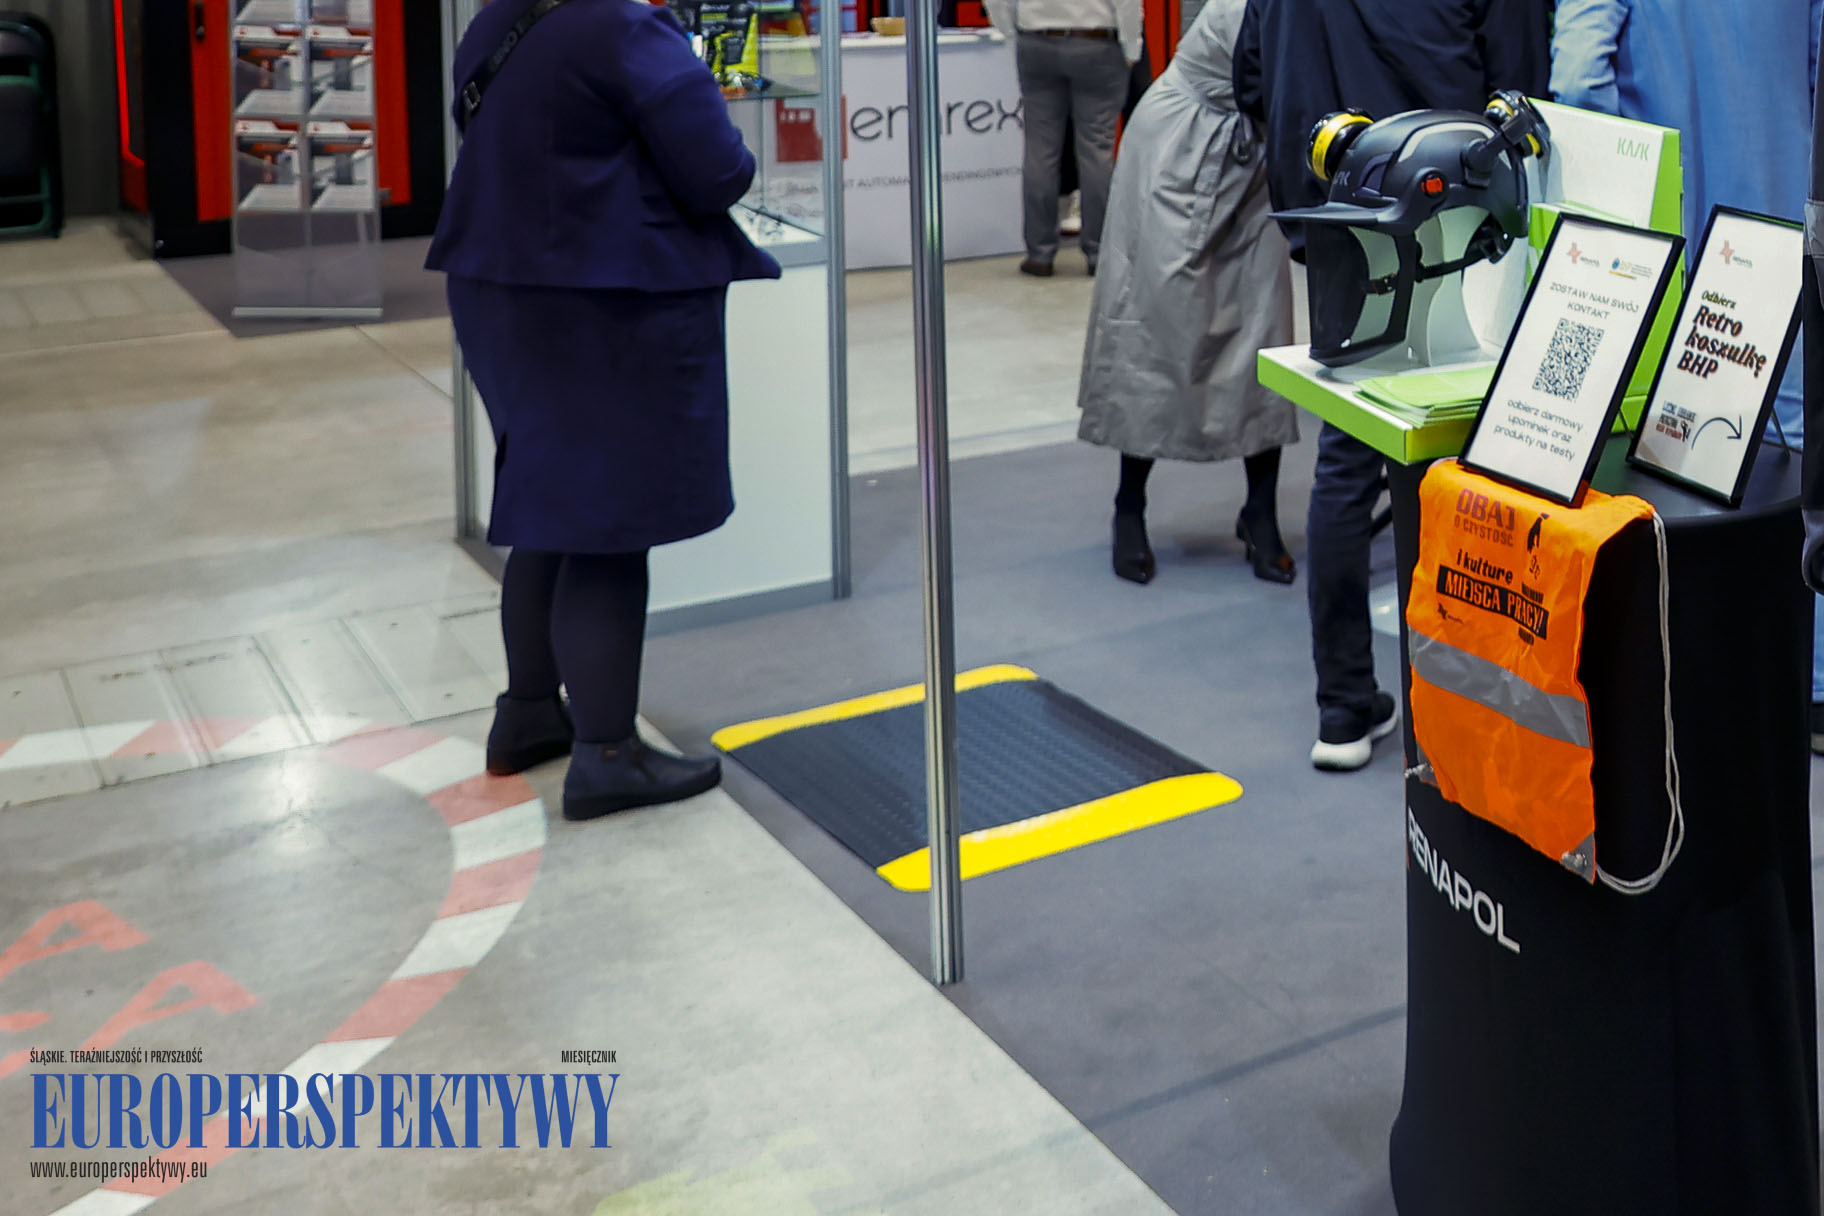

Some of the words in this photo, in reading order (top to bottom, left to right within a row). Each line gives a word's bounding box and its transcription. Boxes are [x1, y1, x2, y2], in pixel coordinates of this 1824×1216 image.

[1616, 137, 1650, 161] KASK
[1550, 282, 1587, 299] ZOSTAW
[1590, 293, 1610, 305] NAM
[1611, 298, 1639, 313] SWÓJ
[1567, 302, 1611, 320] KONTAKT
[1701, 290, 1737, 310] Odbierz
[1693, 304, 1743, 337] Retro
[1677, 349, 1719, 379] BHP
[1685, 325, 1767, 378] koszulkę
[1507, 399, 1540, 417] odbierz
[1541, 409, 1583, 432] darmowy
[1508, 414, 1550, 435] upominek
[1551, 429, 1572, 443] oraz
[1494, 425, 1535, 447] produkty
[1536, 439, 1548, 450] na
[1550, 443, 1575, 461] testy
[1456, 548, 1463, 566] i
[1445, 570, 1501, 612] MIEJSCA
[1507, 591, 1545, 634] PRACY!
[1408, 805, 1521, 955] RENAPOL
